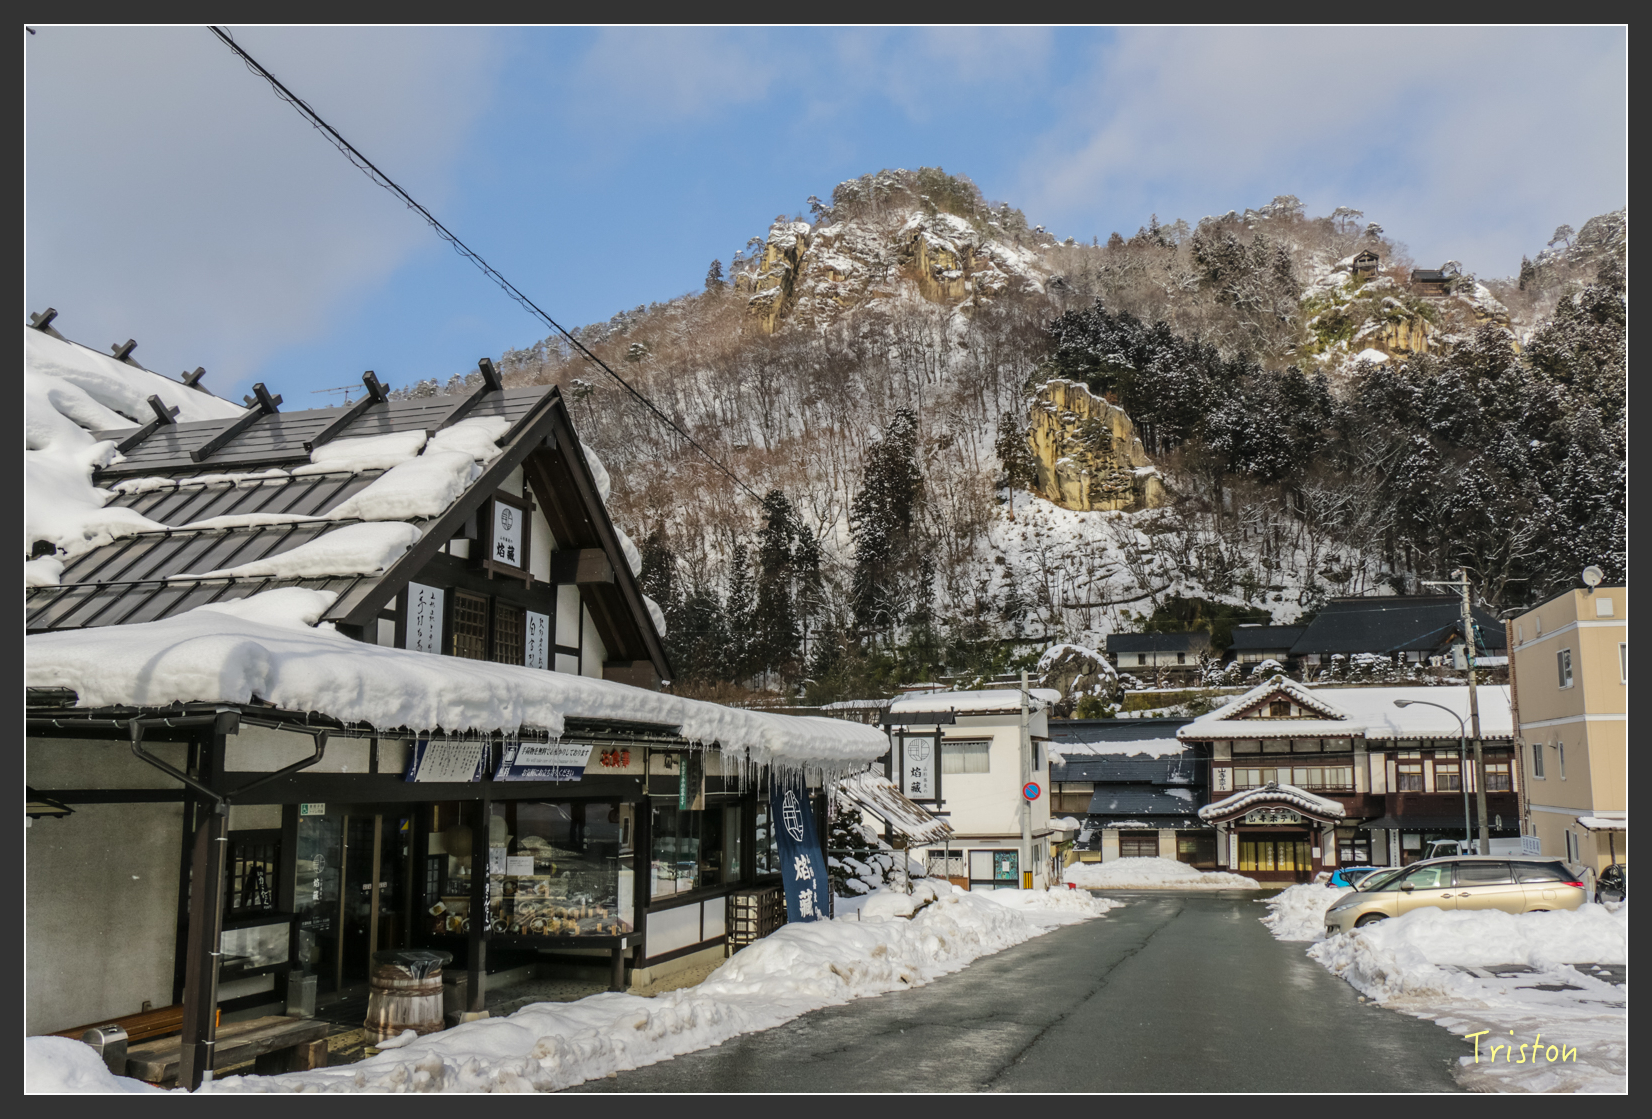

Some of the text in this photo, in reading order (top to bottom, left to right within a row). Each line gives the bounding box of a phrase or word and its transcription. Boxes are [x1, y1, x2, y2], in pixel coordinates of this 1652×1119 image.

[1217, 768, 1227, 791] 山寺ホテル
[1247, 814, 1299, 824] 山寺ホテル
